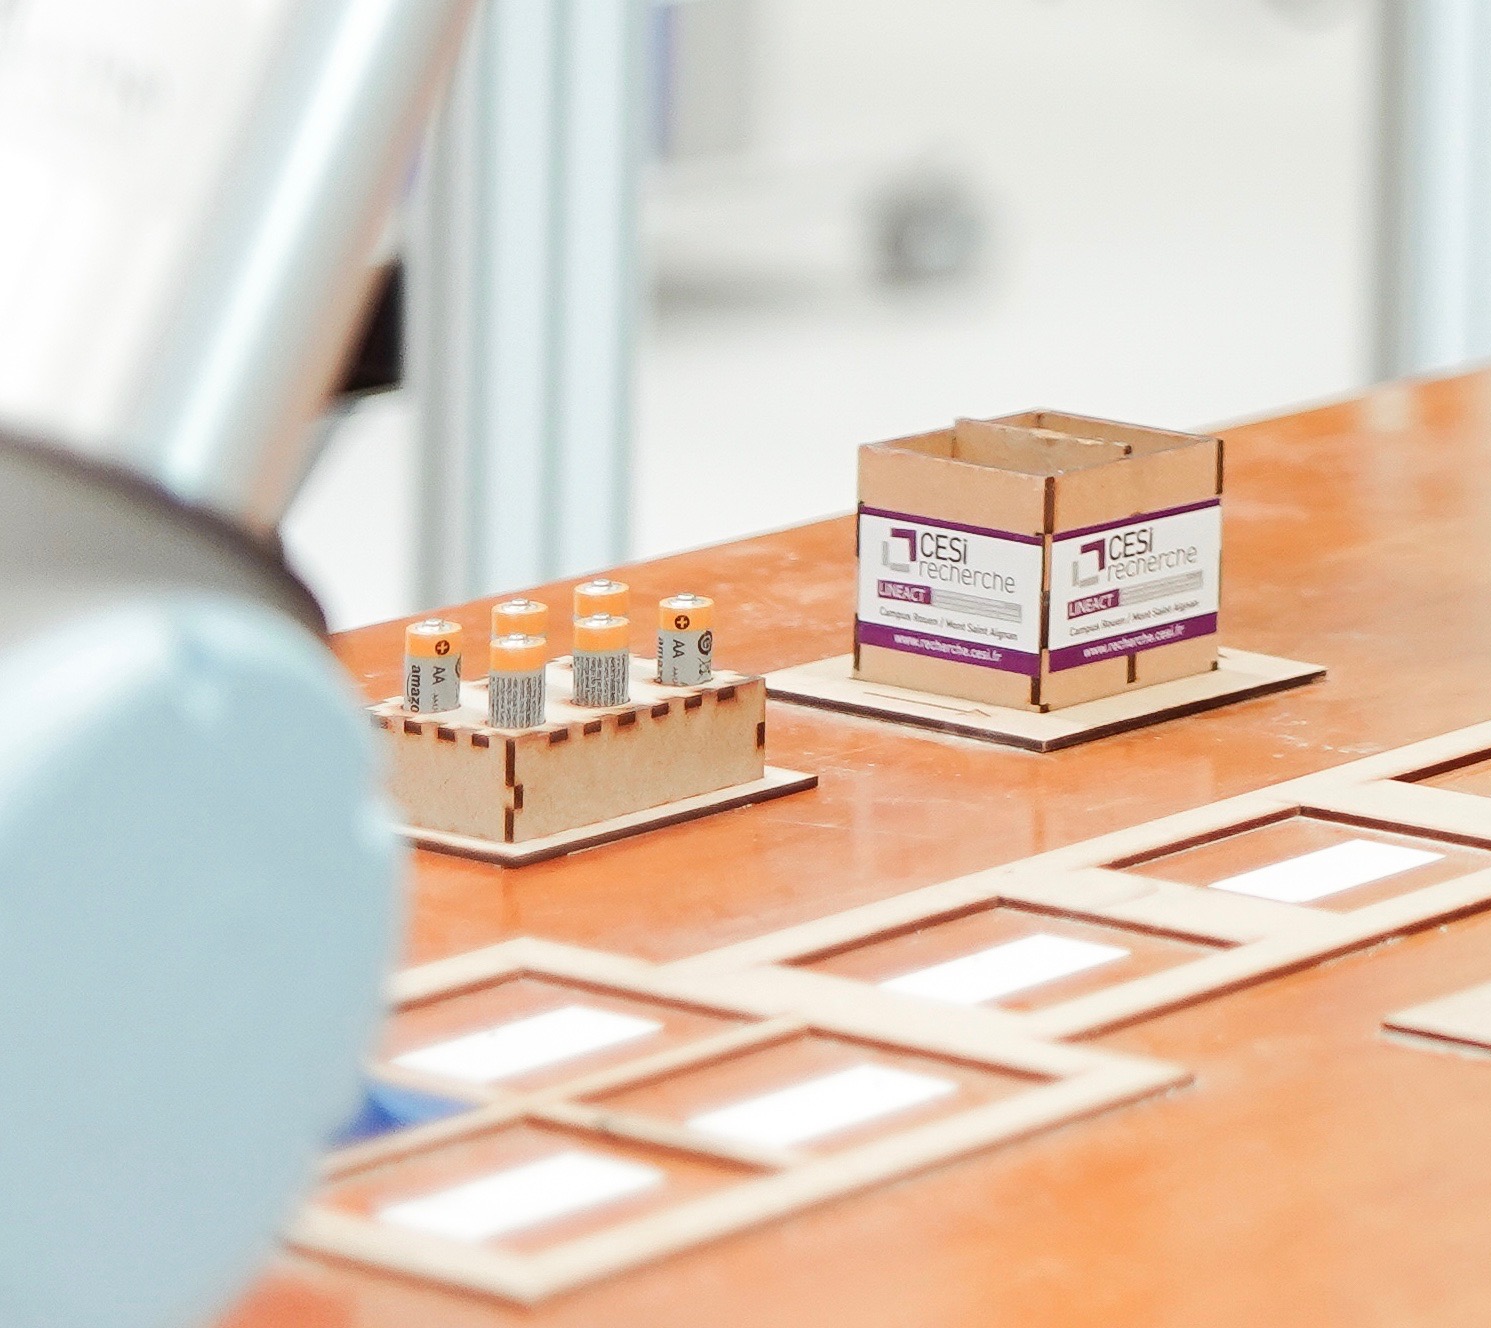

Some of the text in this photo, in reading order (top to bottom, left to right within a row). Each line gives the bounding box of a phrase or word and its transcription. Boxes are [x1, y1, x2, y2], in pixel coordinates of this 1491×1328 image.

[1106, 545, 1197, 581] recherche
[918, 560, 1016, 594] recherche
[878, 582, 926, 603] LINEACT
[1068, 594, 1115, 618] LINEACT
[879, 606, 911, 621] Campus
[913, 613, 938, 626] Rouen
[967, 623, 988, 635] Saint
[1069, 623, 1100, 636] Campus
[672, 639, 685, 659] AA
[891, 634, 1003, 662] www.recherche.cesi.fr
[432, 665, 446, 685] AA
